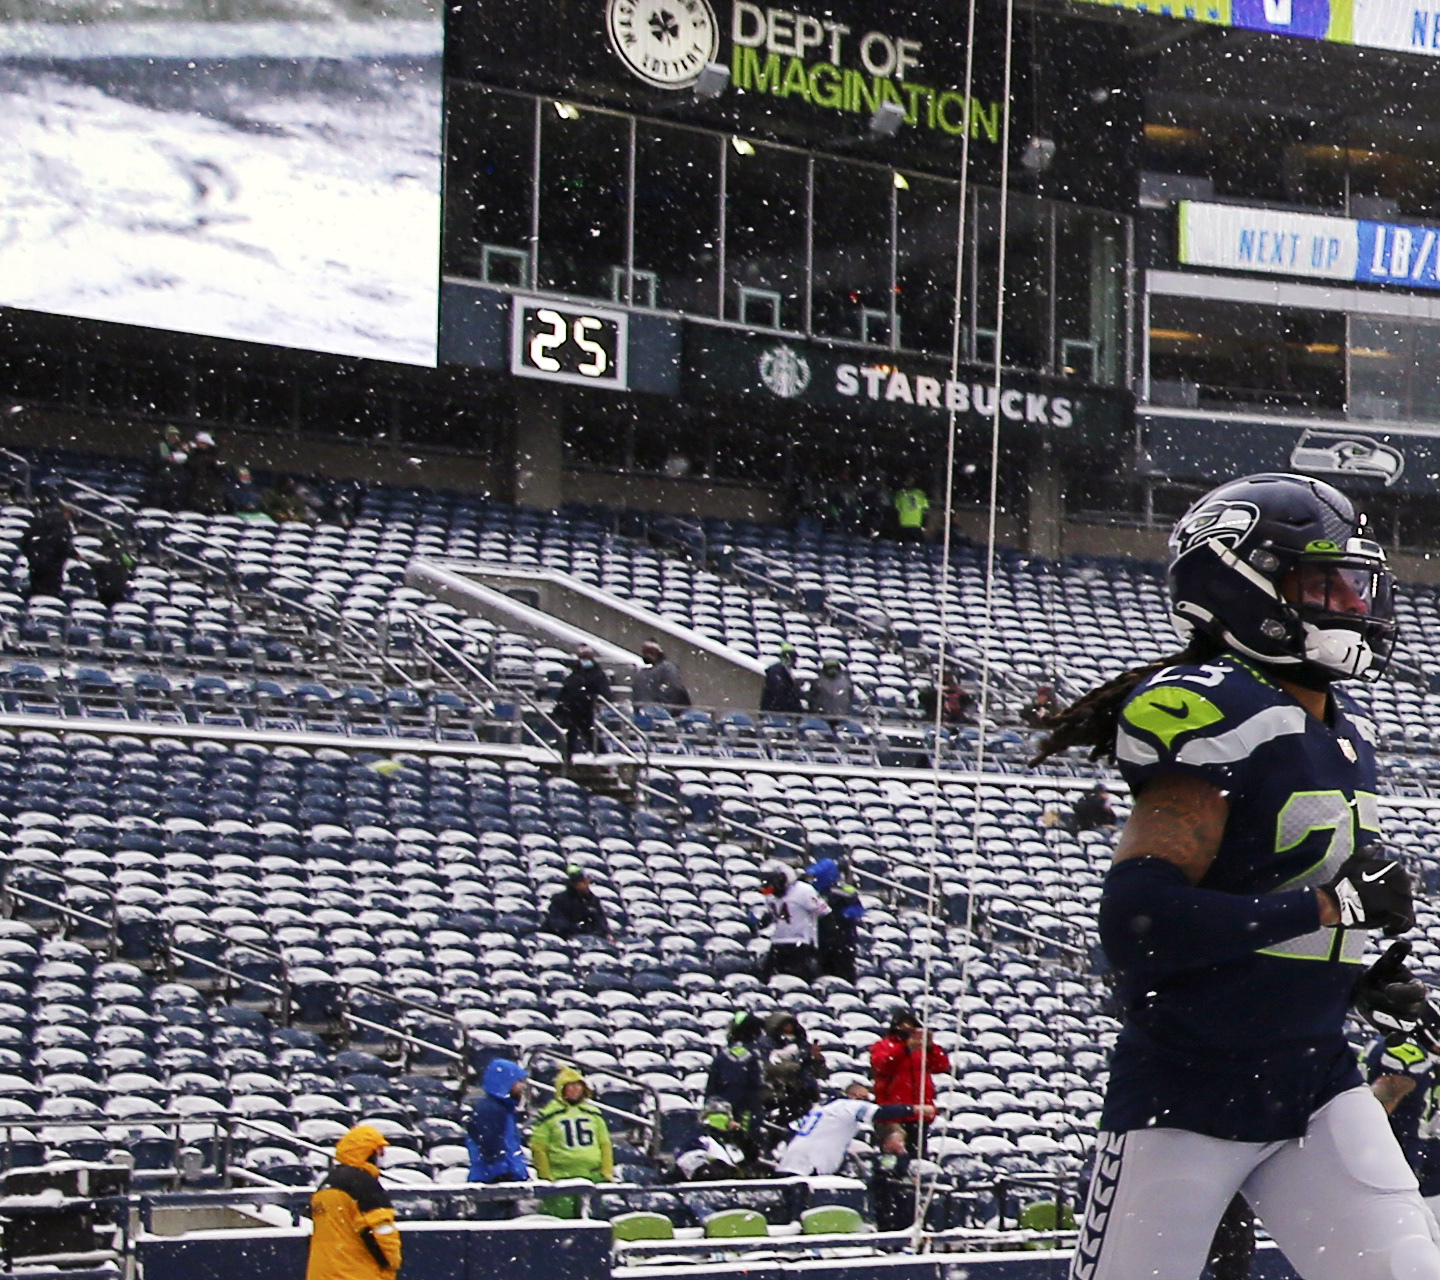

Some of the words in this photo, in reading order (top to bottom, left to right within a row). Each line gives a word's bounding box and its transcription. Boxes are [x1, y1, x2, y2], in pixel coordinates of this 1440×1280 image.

[732, 0, 851, 67] DEPT
[860, 31, 922, 81] OF
[1238, 227, 1304, 268] NEXT
[1310, 234, 1341, 269] UP
[529, 309, 607, 380] 25
[836, 362, 1074, 429] STARBUCKS
[560, 1118, 594, 1148] 16
